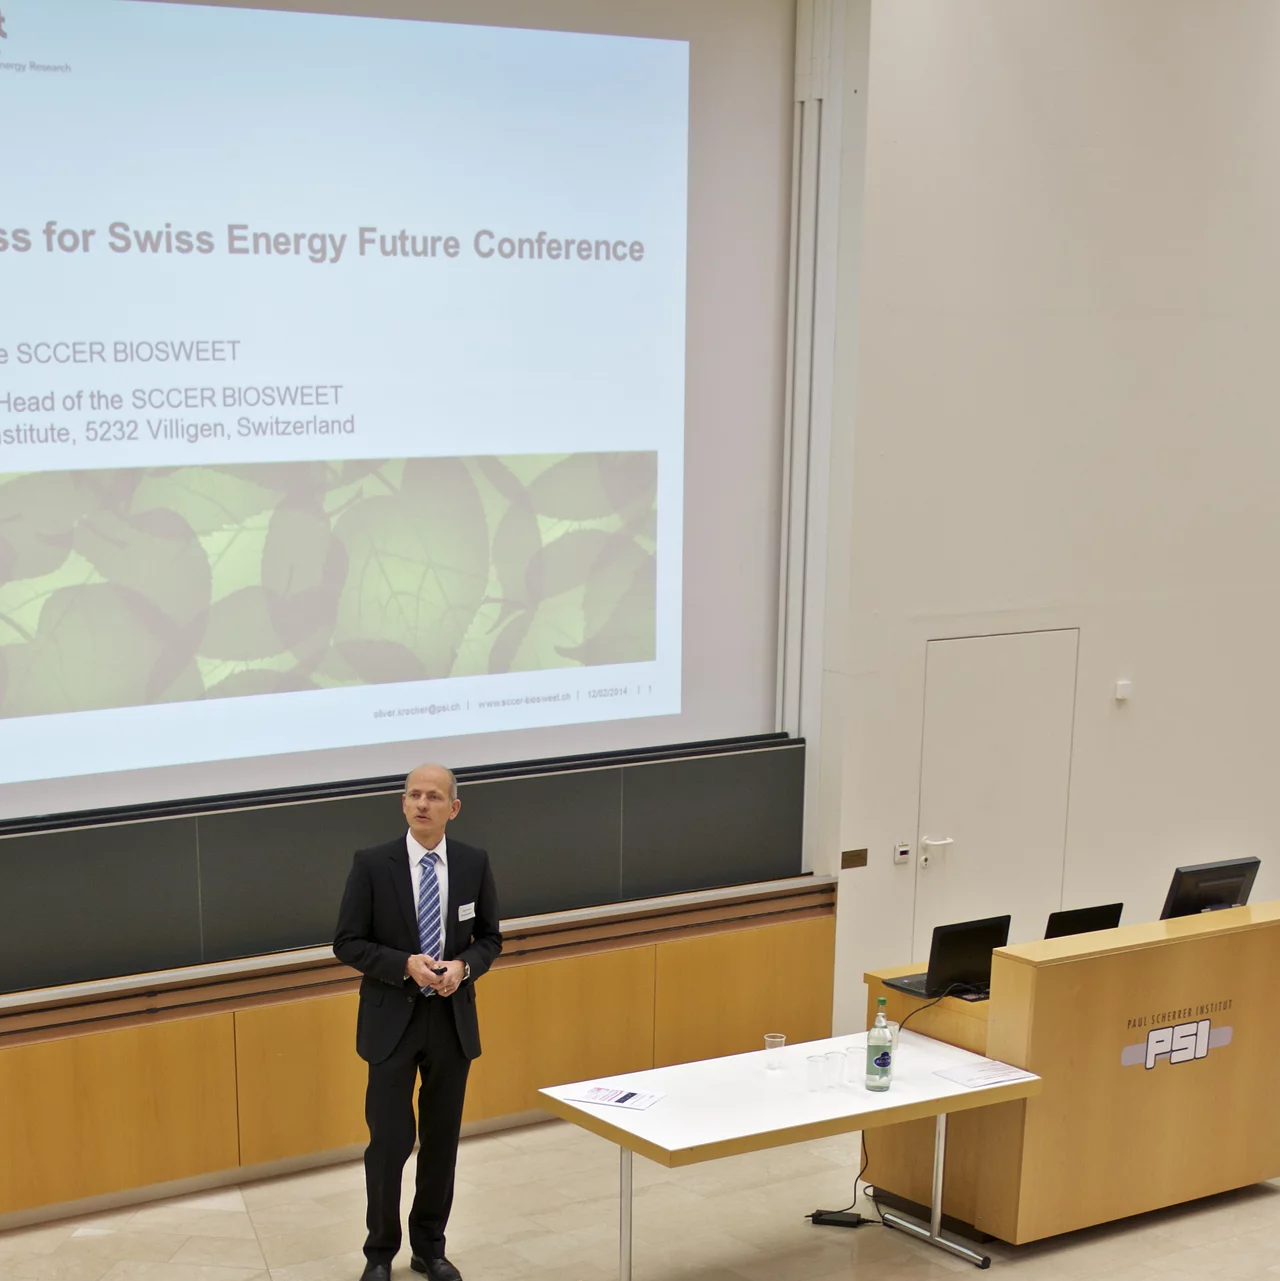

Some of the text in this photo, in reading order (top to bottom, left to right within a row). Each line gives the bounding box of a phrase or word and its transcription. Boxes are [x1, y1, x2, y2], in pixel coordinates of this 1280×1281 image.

[29, 61, 72, 73] Research
[43, 220, 96, 253] for
[108, 221, 216, 254] Swiss
[227, 224, 347, 264] Energy
[358, 226, 460, 258] Future
[473, 229, 645, 261] Conference
[16, 342, 107, 364] SCCER
[113, 340, 241, 362] BIOSWEET
[62, 390, 83, 411] of
[89, 390, 124, 411] the
[131, 387, 217, 409] SCCER
[222, 385, 343, 408] BIOSWEET
[85, 420, 139, 442] 5232
[146, 418, 232, 443] Villigen,
[237, 415, 355, 437] Switzerland
[588, 686, 628, 699] 12/02/2014
[1127, 999, 1233, 1030] PAUL SCHERRER INSTITUT
[1144, 1018, 1212, 1070] PSI
